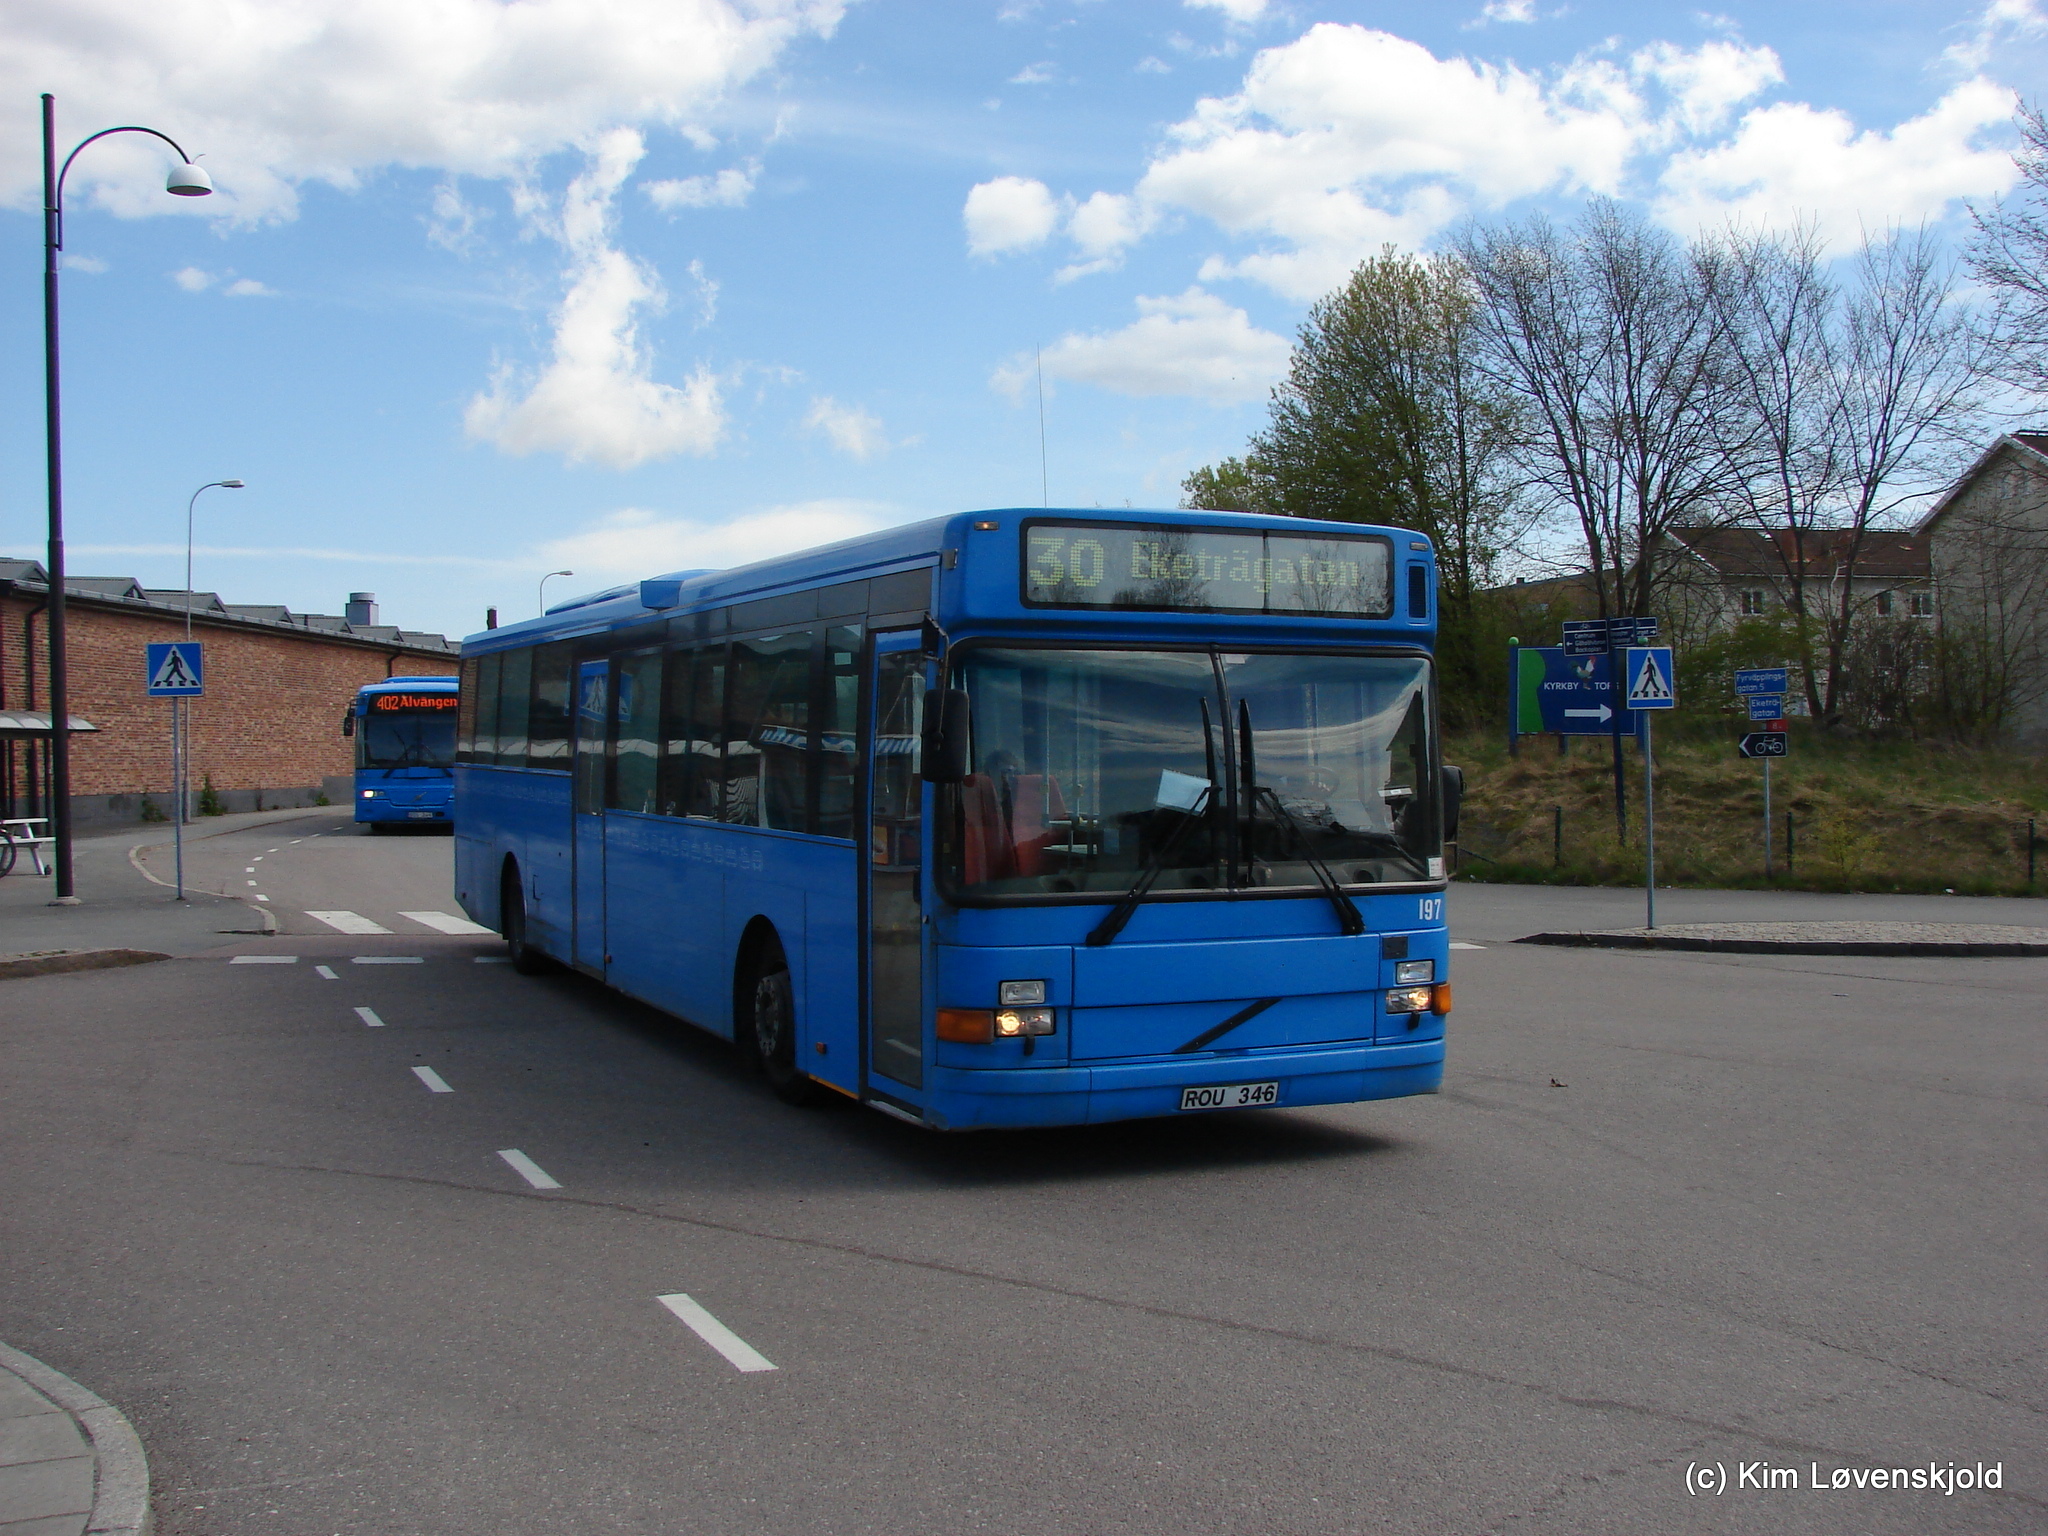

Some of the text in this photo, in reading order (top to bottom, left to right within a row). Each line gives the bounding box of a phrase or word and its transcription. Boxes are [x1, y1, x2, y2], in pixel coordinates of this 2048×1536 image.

[1029, 537, 1360, 593] 30 Eketrägatan
[1543, 682, 1579, 690] KYRKBY
[1736, 683, 1765, 694] gatan 5
[377, 695, 399, 710] 402
[1752, 709, 1776, 719] gatan
[1418, 898, 1442, 921] 197
[1184, 1084, 1275, 1108] ROU 346
